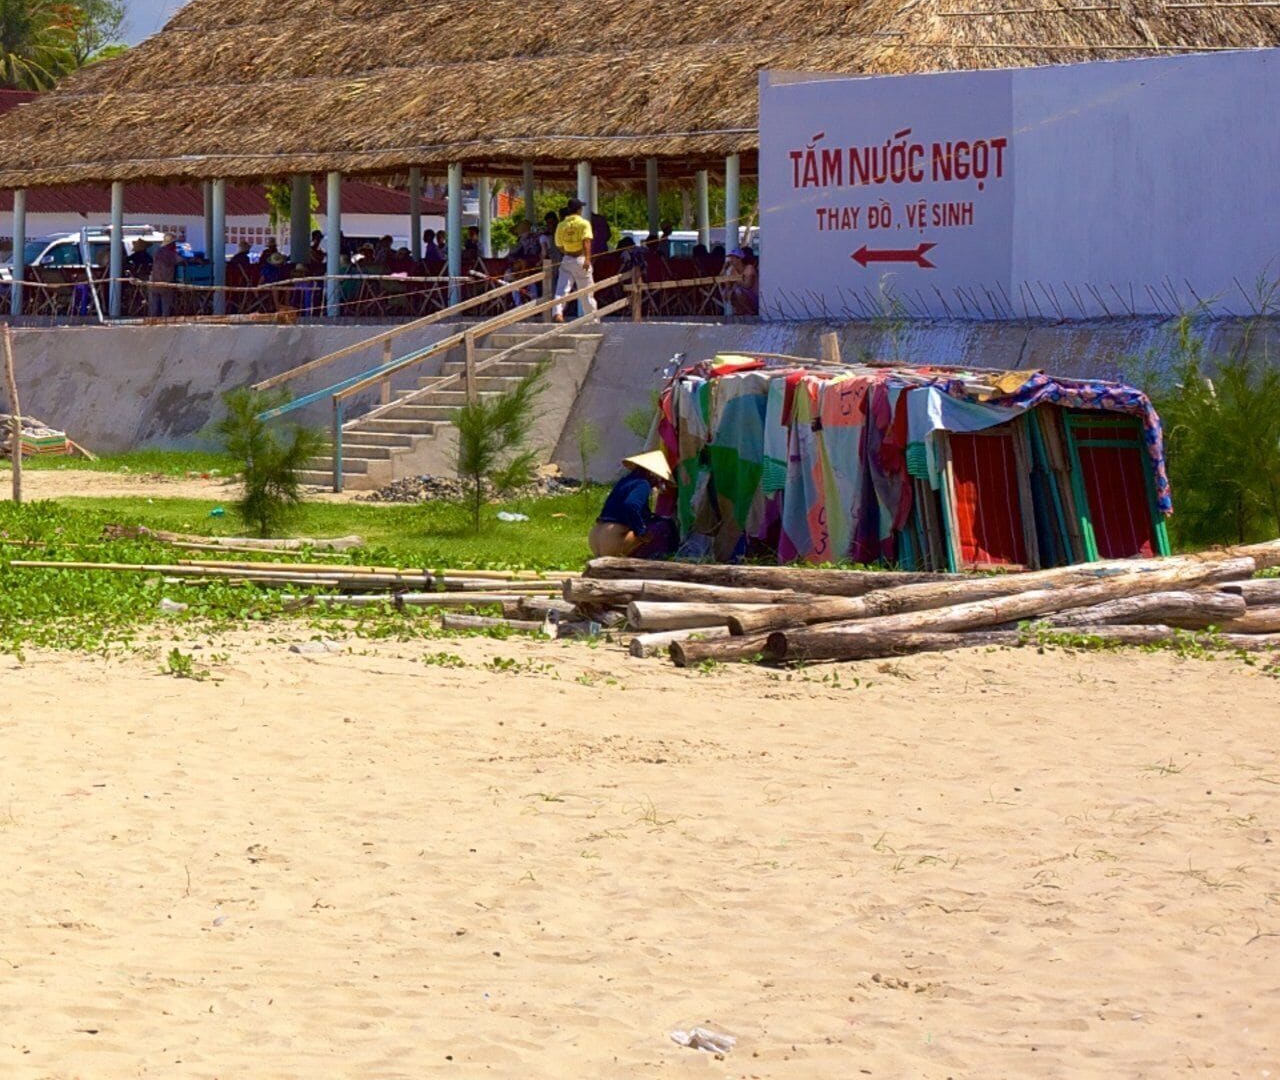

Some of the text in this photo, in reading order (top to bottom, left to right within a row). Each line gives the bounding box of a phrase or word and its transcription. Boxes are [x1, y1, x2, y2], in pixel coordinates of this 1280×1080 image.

[790, 128, 1007, 191] TẮM NƯỚC NGỌT
[816, 207, 860, 230] THAY
[906, 199, 927, 233] VỆ
[933, 202, 973, 226] SINH
